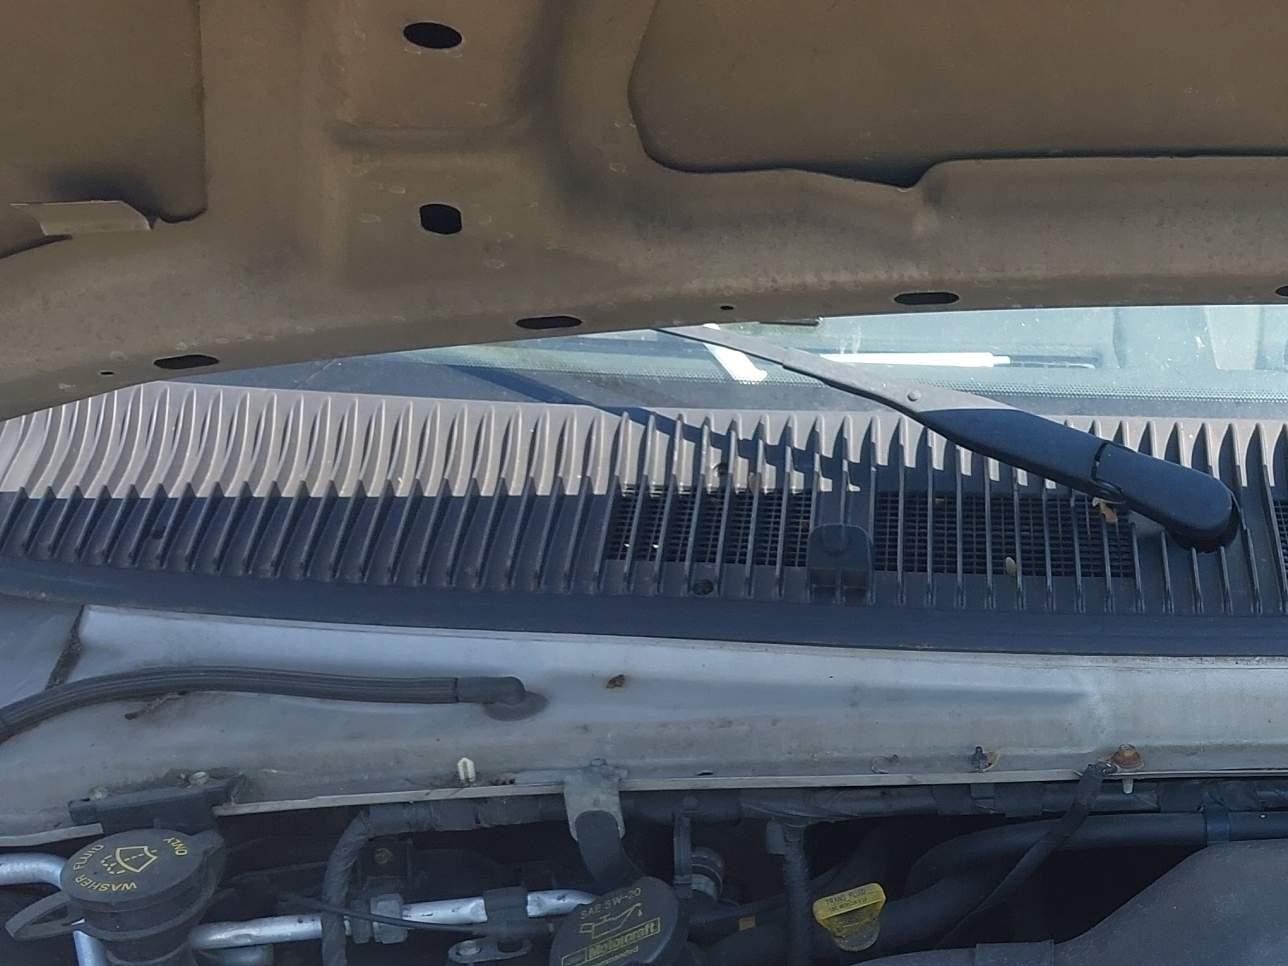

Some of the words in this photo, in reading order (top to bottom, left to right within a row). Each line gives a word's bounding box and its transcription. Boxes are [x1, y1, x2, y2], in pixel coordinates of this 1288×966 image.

[73, 844, 104, 871] FLUID
[162, 837, 188, 856] ONLY
[75, 874, 137, 892] WASHER
[591, 922, 655, 957] Motorcraft
